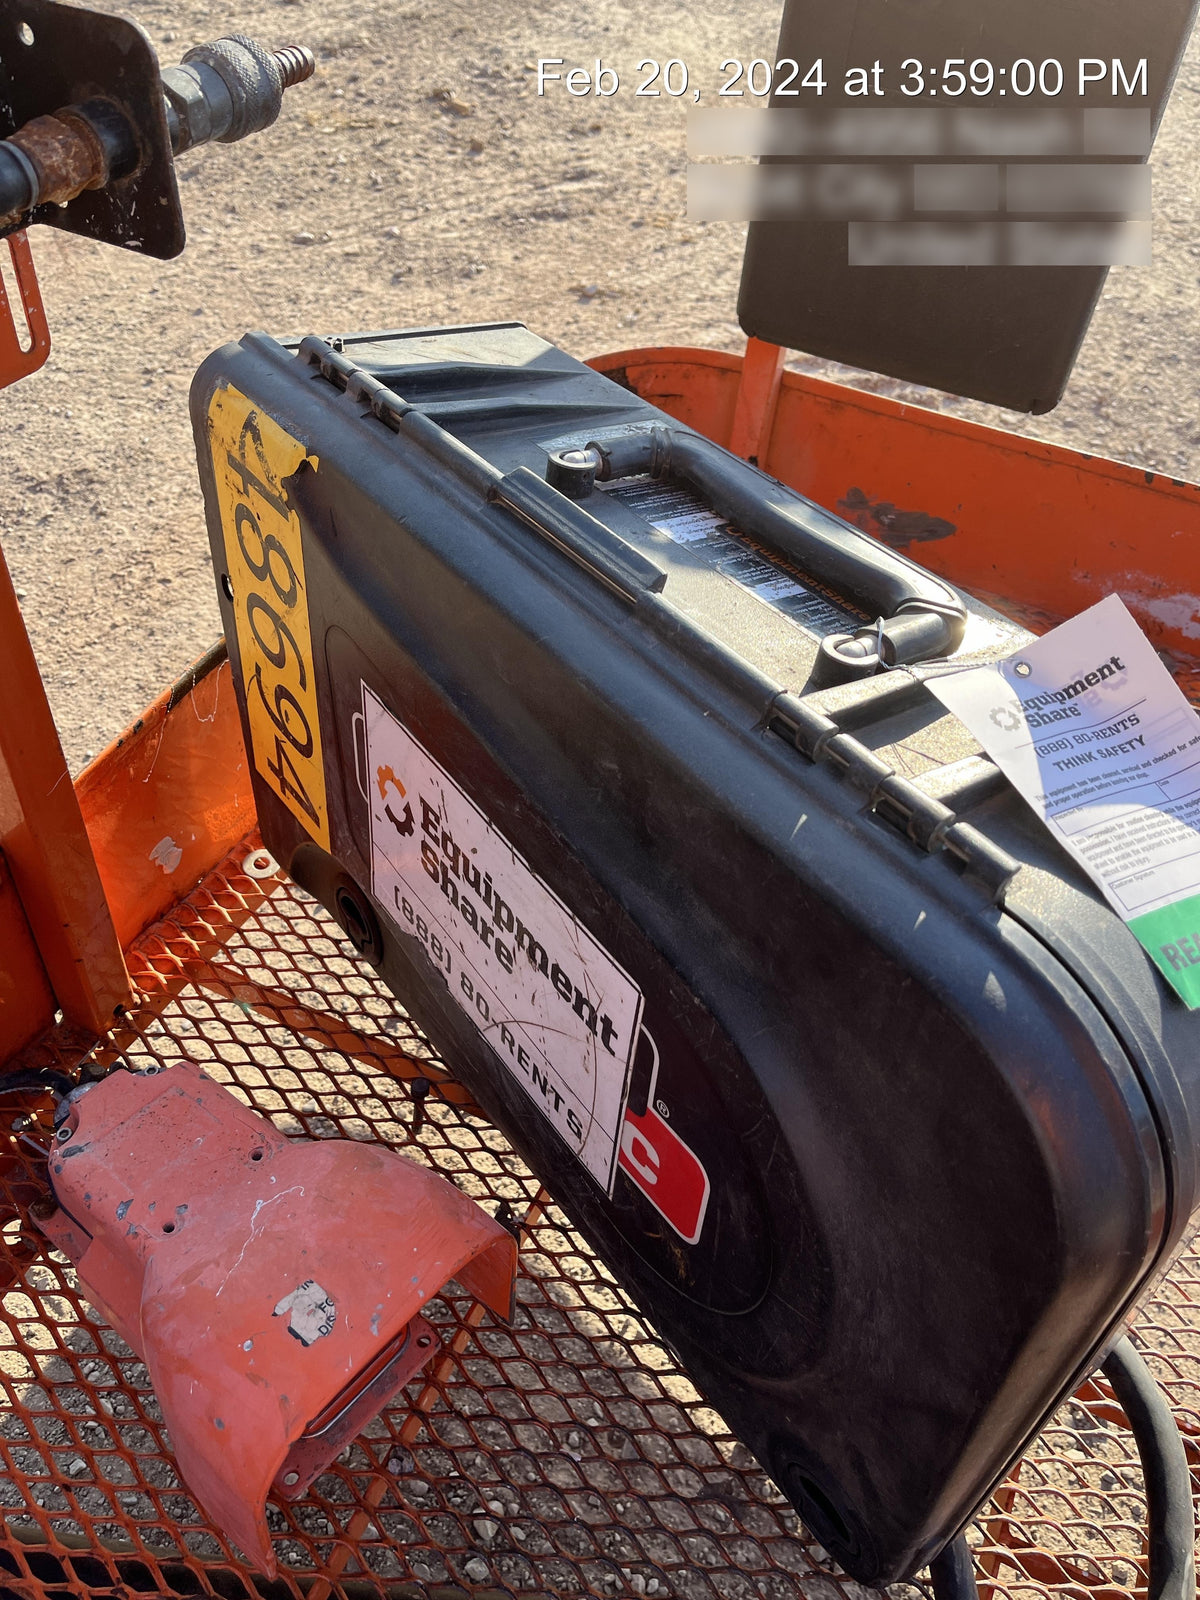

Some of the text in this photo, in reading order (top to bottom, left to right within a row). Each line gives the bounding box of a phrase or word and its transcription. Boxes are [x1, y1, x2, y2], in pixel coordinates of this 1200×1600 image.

[1009, 655, 1126, 713] Equipment
[1026, 704, 1081, 728] Share
[1034, 713, 1140, 758] (888) 80-RENTS
[1052, 734, 1146, 772] THINK SAFETY
[1152, 748, 1177, 764] checked
[1176, 743, 1187, 752] for
[419, 793, 618, 1057] Equipment
[421, 835, 514, 975] Share
[394, 885, 584, 1145] (888) 80-RENTS
